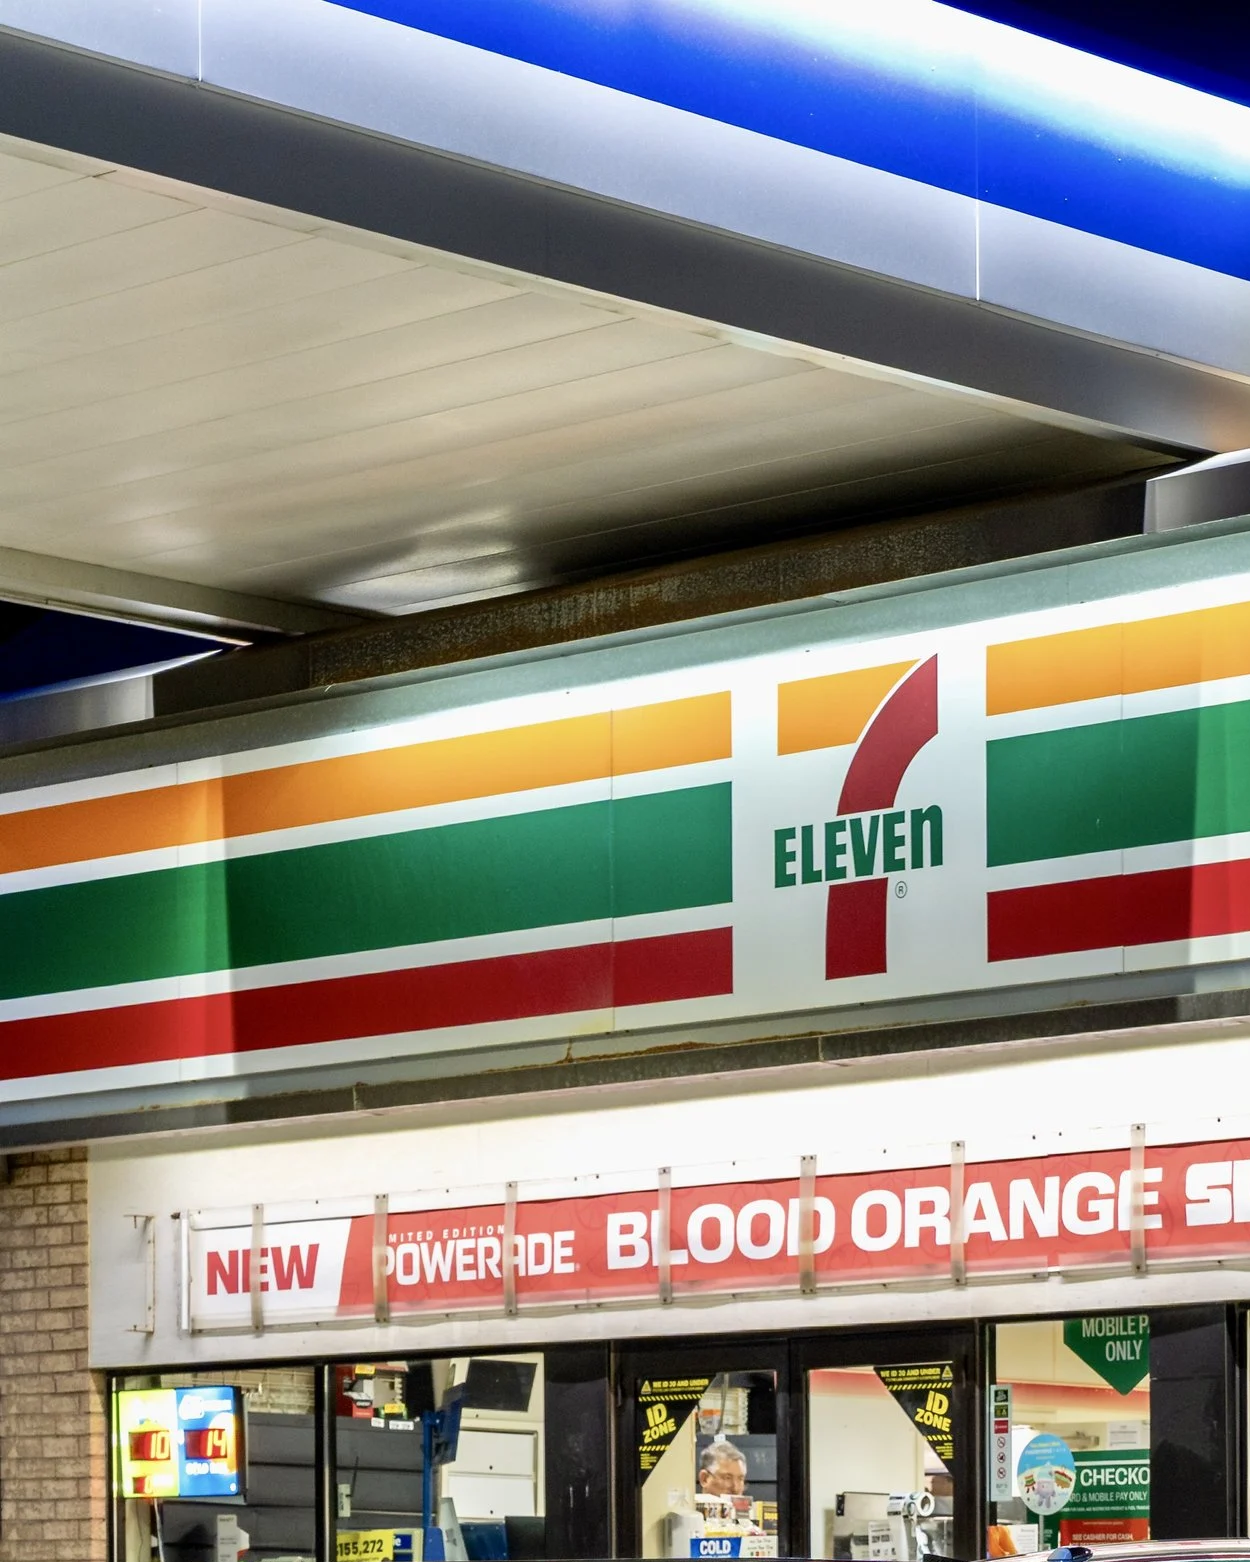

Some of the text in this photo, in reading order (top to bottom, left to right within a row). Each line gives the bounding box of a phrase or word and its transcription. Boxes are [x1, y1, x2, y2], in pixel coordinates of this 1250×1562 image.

[777, 653, 938, 980] 7
[206, 1243, 320, 1296] NEW
[606, 1196, 836, 1271] BLOOD
[851, 1167, 1164, 1253] ORANGE
[1082, 1316, 1136, 1338] MOBILE
[1105, 1339, 1143, 1362] ONLY
[925, 1390, 949, 1415] ID
[646, 1403, 667, 1428] ID
[914, 1408, 952, 1432] ZONE
[642, 1418, 676, 1444] ZONE
[1088, 1491, 1114, 1502] MOBILE
[1115, 1491, 1128, 1501] PAY
[1128, 1490, 1148, 1501] ONLY
[699, 1539, 731, 1555] COLD
